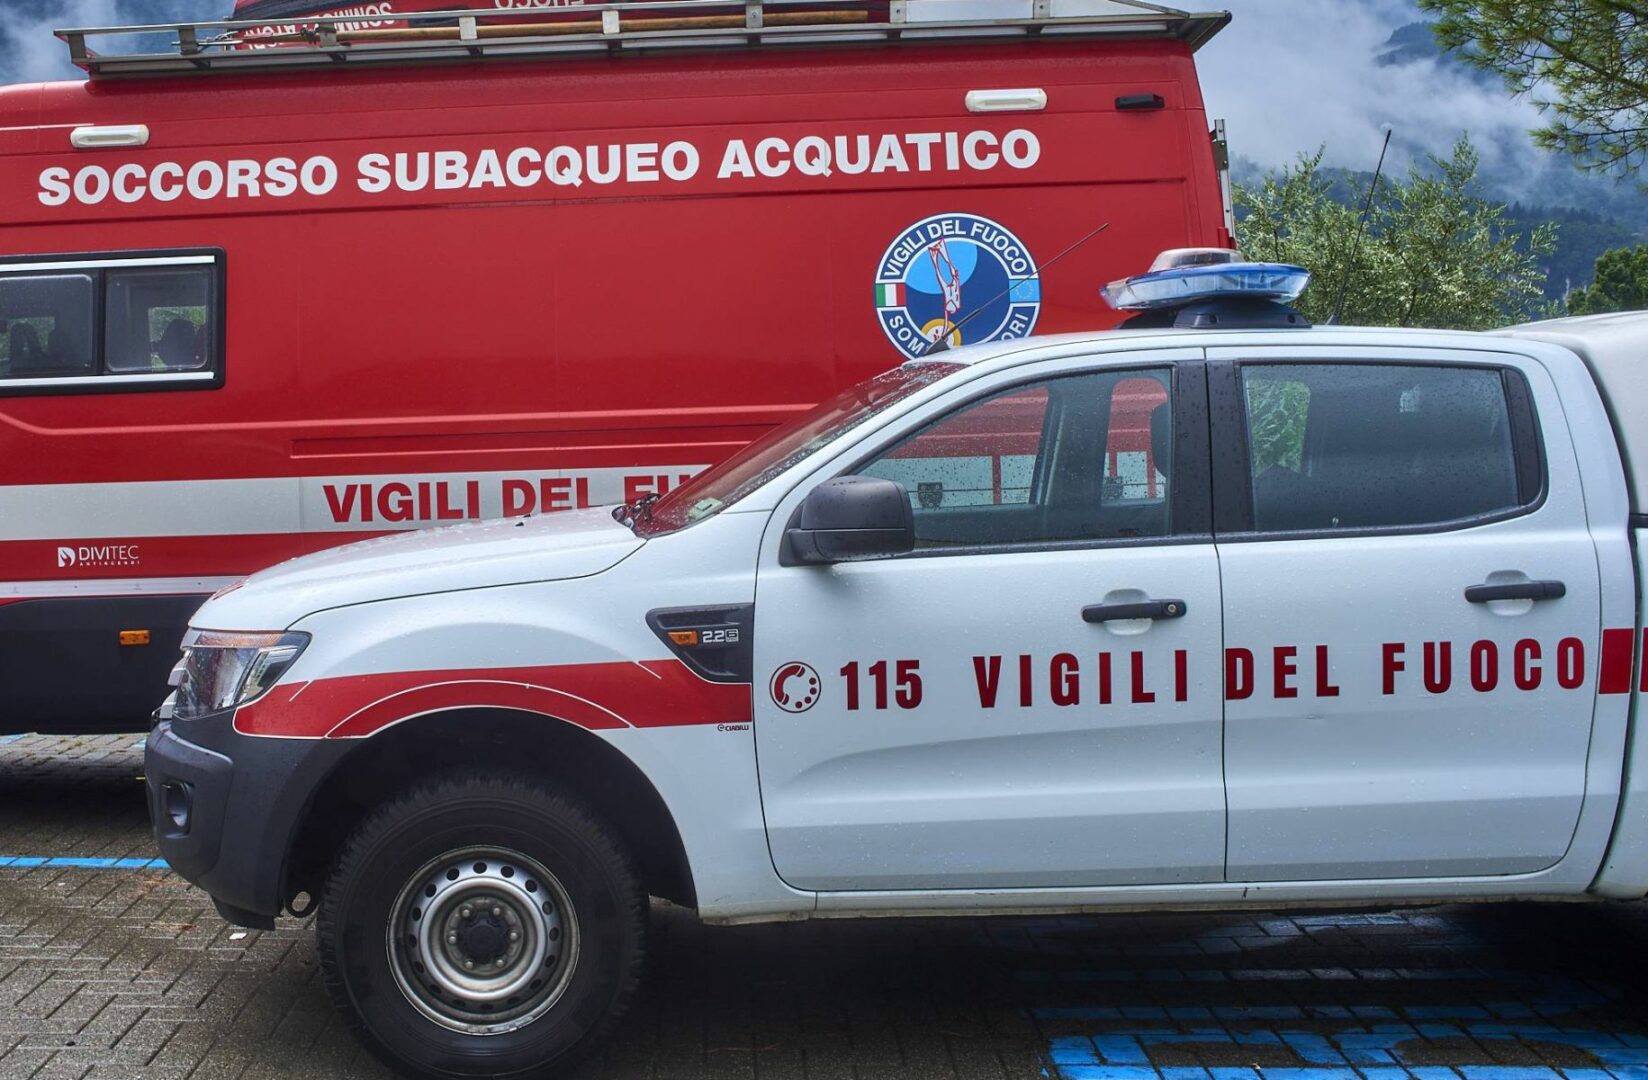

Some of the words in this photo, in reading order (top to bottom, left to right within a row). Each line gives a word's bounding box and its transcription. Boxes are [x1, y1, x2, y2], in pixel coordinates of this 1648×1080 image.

[37, 155, 338, 206] SOCCORSO
[357, 140, 700, 194] SUBACQUEO
[716, 128, 1041, 180] ACQUATICO
[884, 229, 927, 277] VIGILI
[927, 219, 967, 240] DEL
[970, 222, 1028, 274] FUOCO
[322, 479, 480, 523] VIGILI
[502, 477, 595, 517] DEL
[79, 545, 139, 560] DIVITEC
[840, 659, 923, 711] 115
[972, 649, 1188, 709] VIGILI
[1225, 644, 1340, 701] DEL
[1382, 637, 1585, 696] FUOCO
